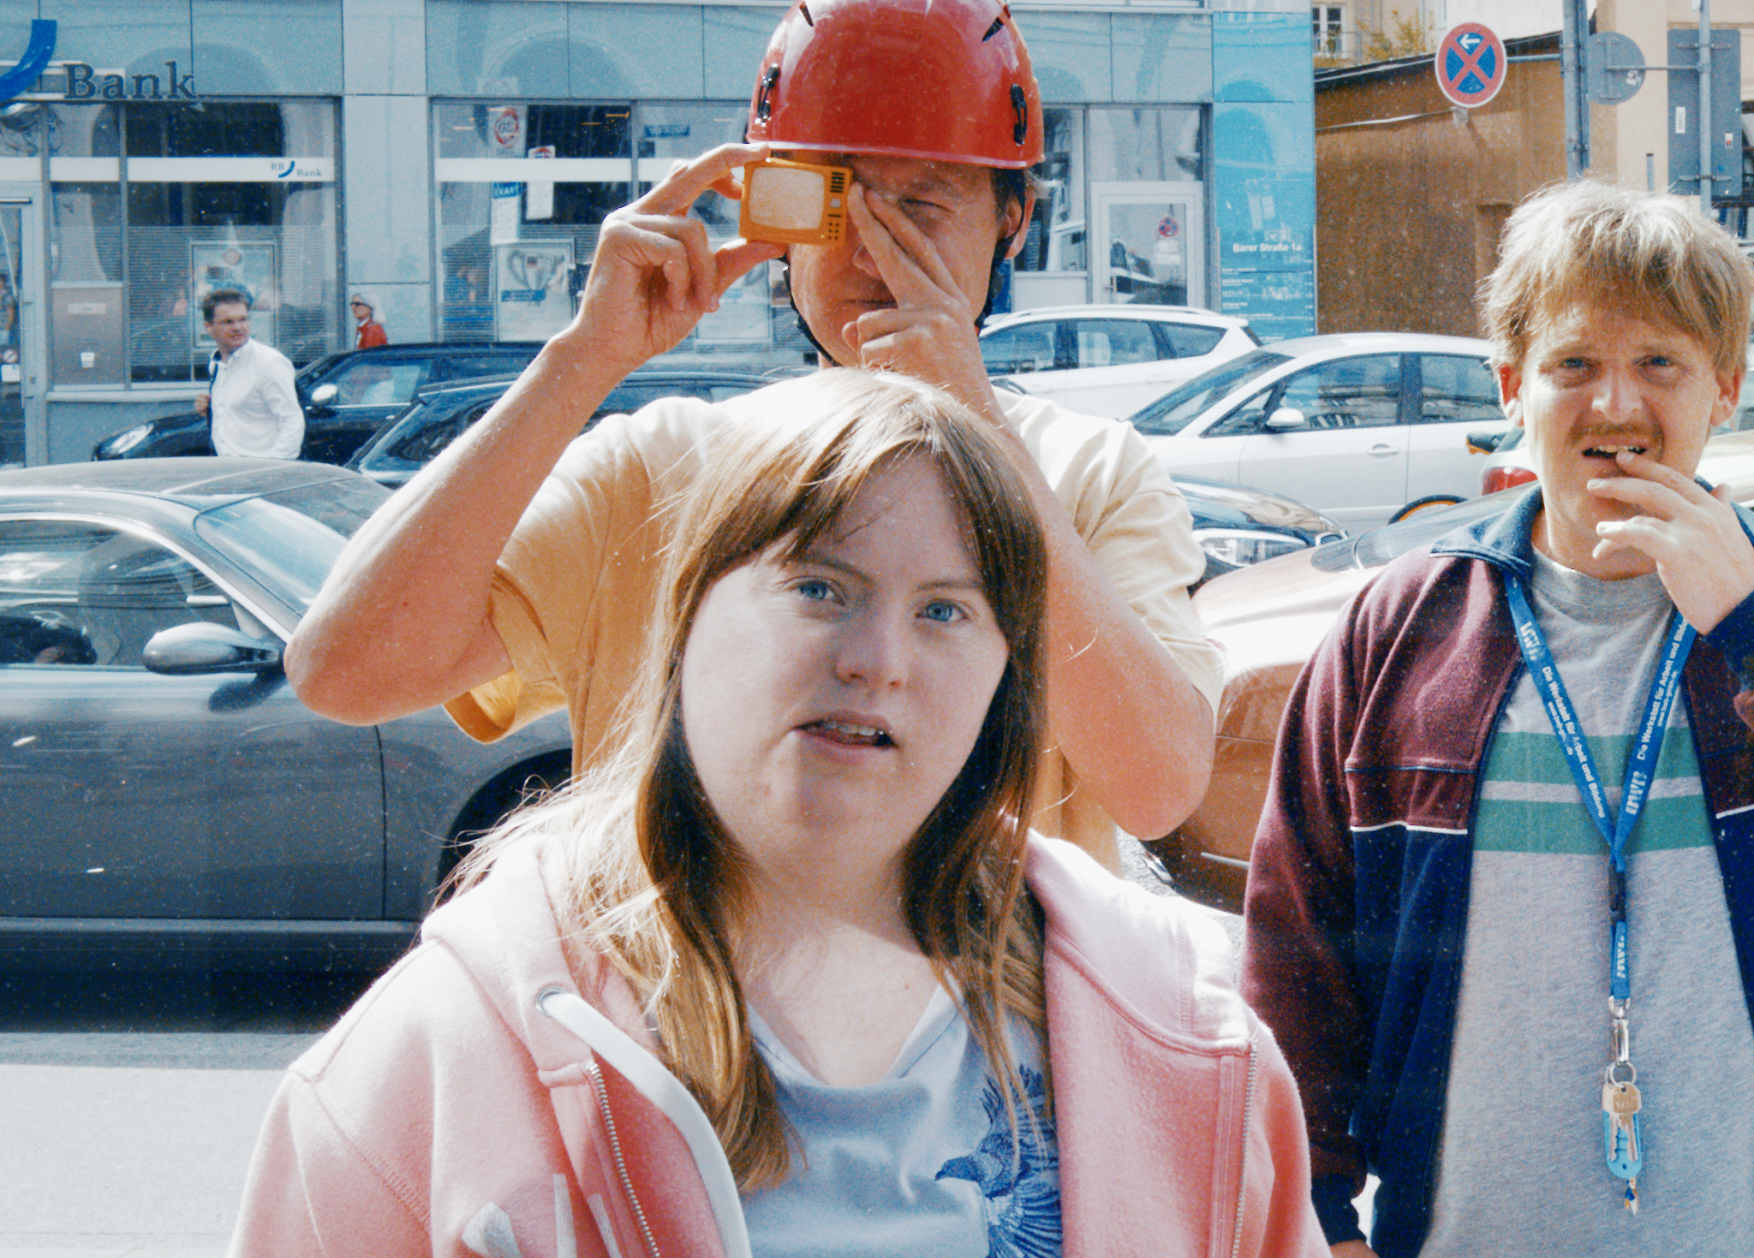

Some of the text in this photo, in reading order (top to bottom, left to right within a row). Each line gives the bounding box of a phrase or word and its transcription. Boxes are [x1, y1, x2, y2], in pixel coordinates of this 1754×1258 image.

[63, 61, 196, 99] Bank
[1669, 641, 1680, 659] und
[1659, 659, 1674, 686] Arbeit
[1542, 666, 1553, 682] Die
[1548, 681, 1571, 721] Werkstatt
[1581, 763, 1595, 782] und
[1641, 700, 1661, 743] Werkstatt
[1636, 743, 1648, 760] Die
